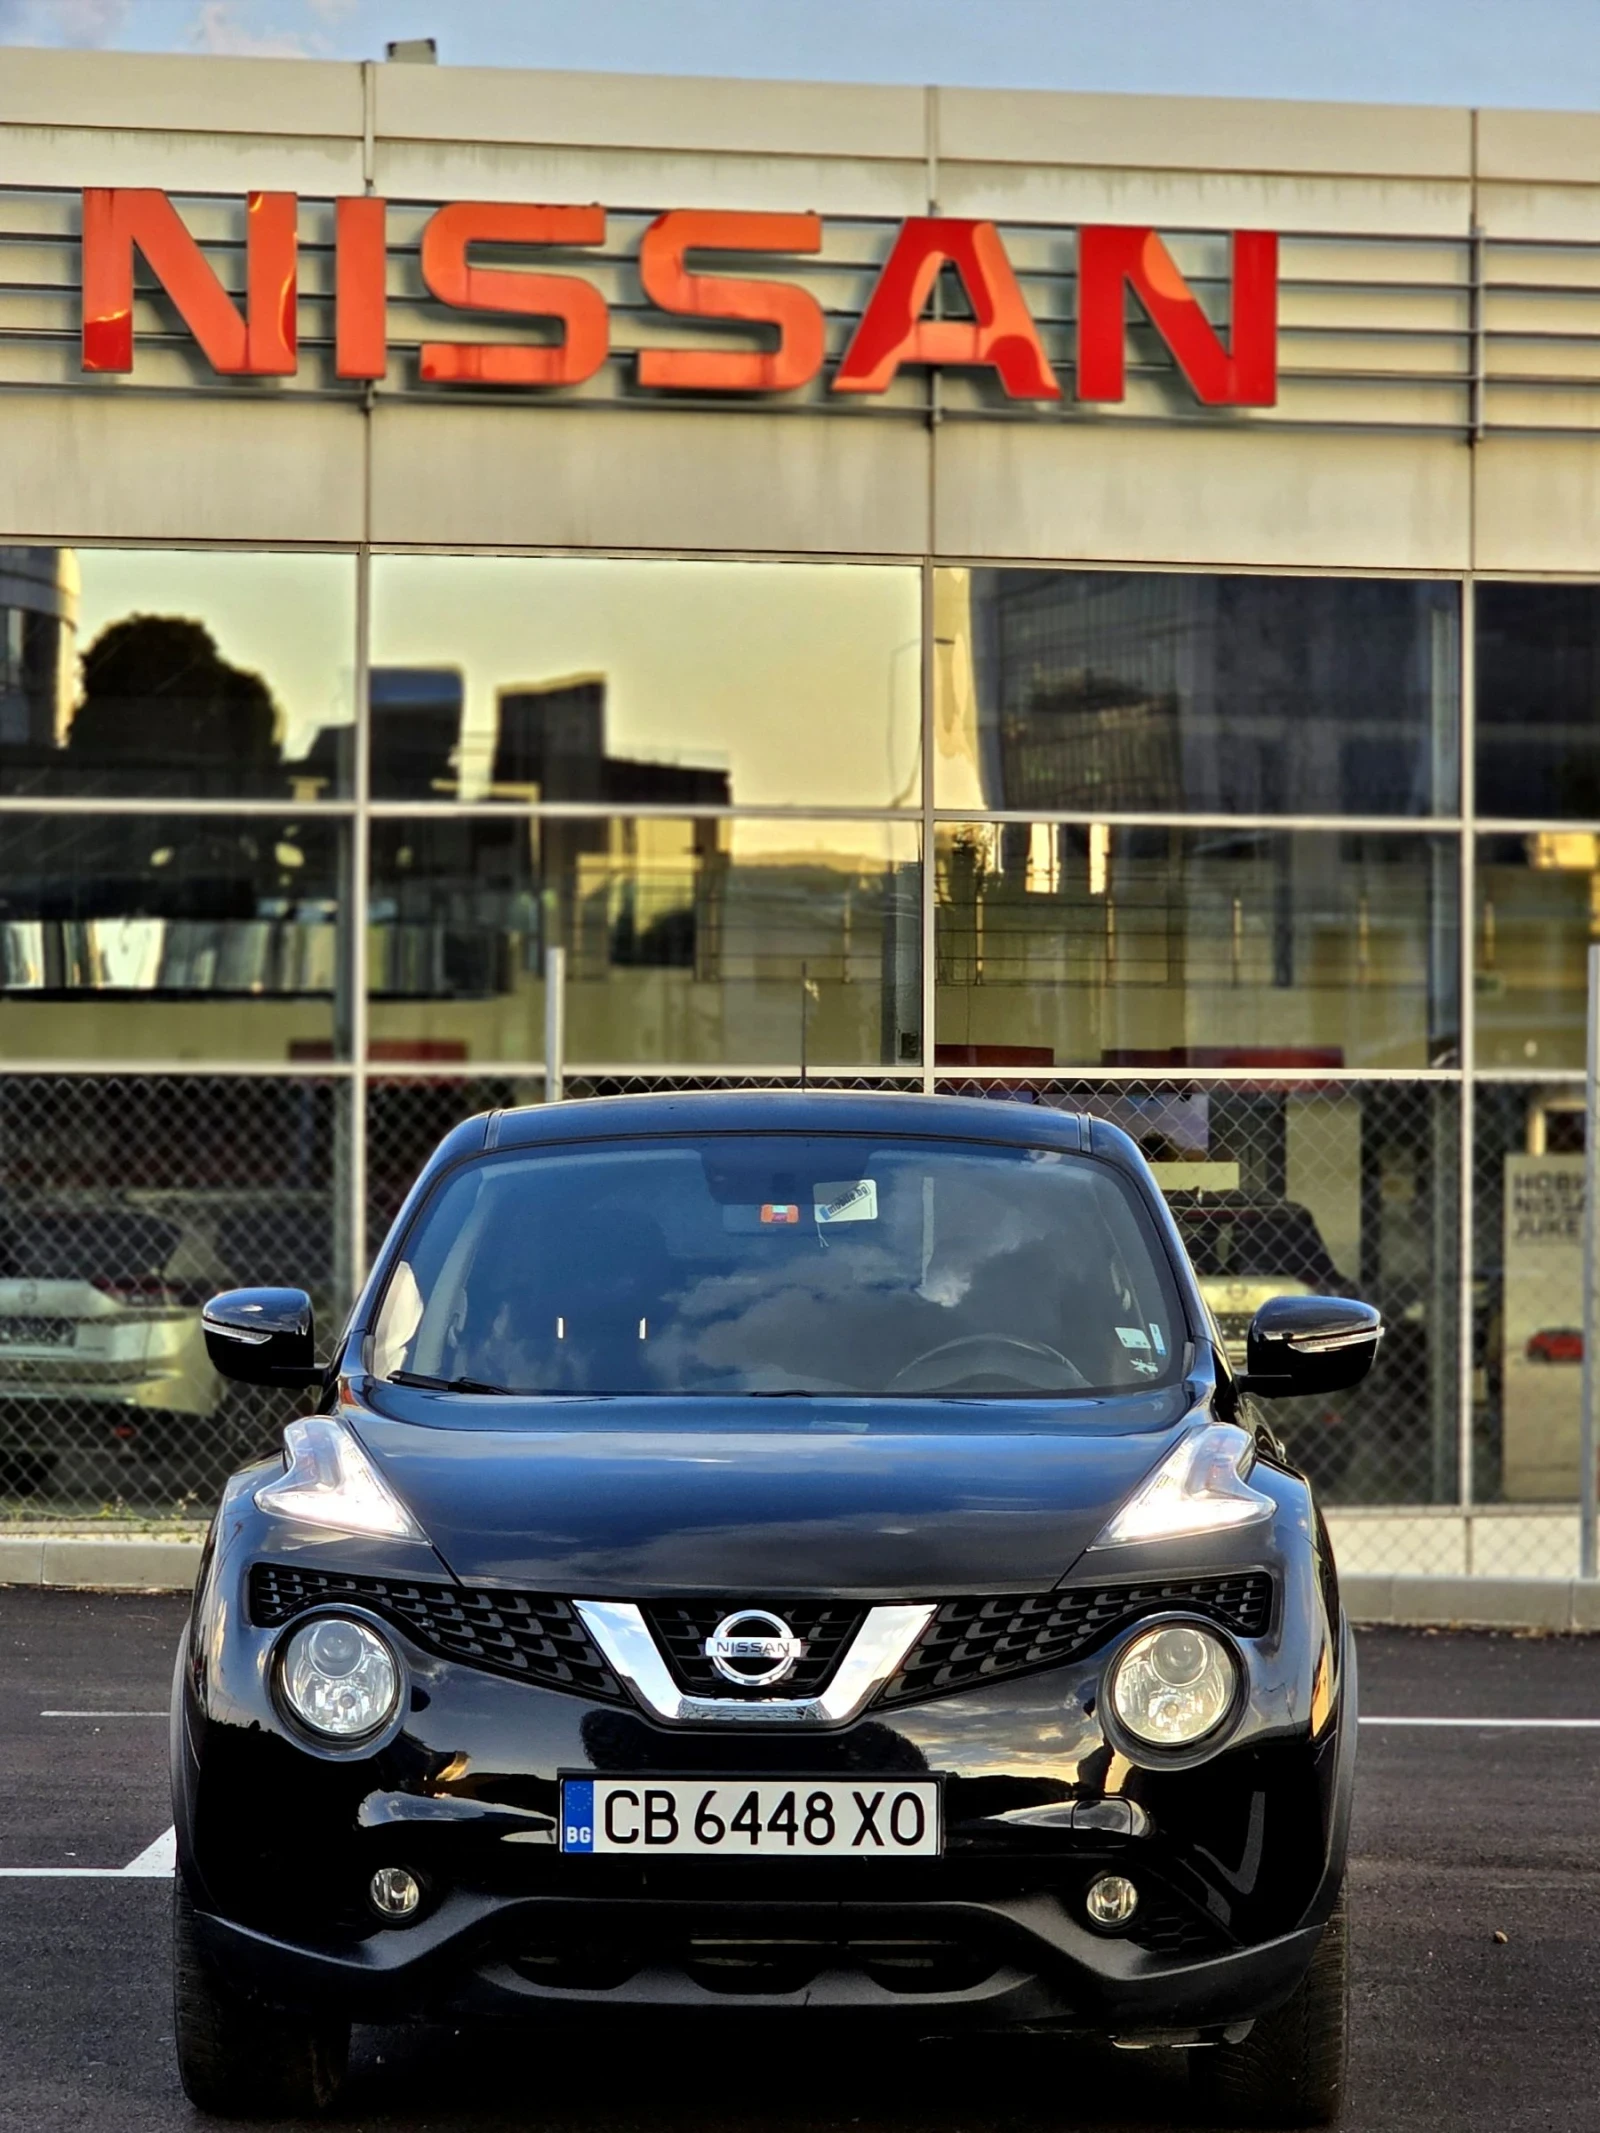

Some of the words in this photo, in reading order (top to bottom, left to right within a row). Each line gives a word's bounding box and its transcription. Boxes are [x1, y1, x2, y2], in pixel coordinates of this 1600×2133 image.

[81, 187, 1278, 406] NISSAN
[1513, 1194, 1585, 1214] NISSA
[716, 1641, 790, 1653] NISSAN
[604, 1789, 679, 1845] CB
[694, 1790, 836, 1846] 6448
[851, 1791, 926, 1847] XO
[566, 1826, 591, 1843] BG
